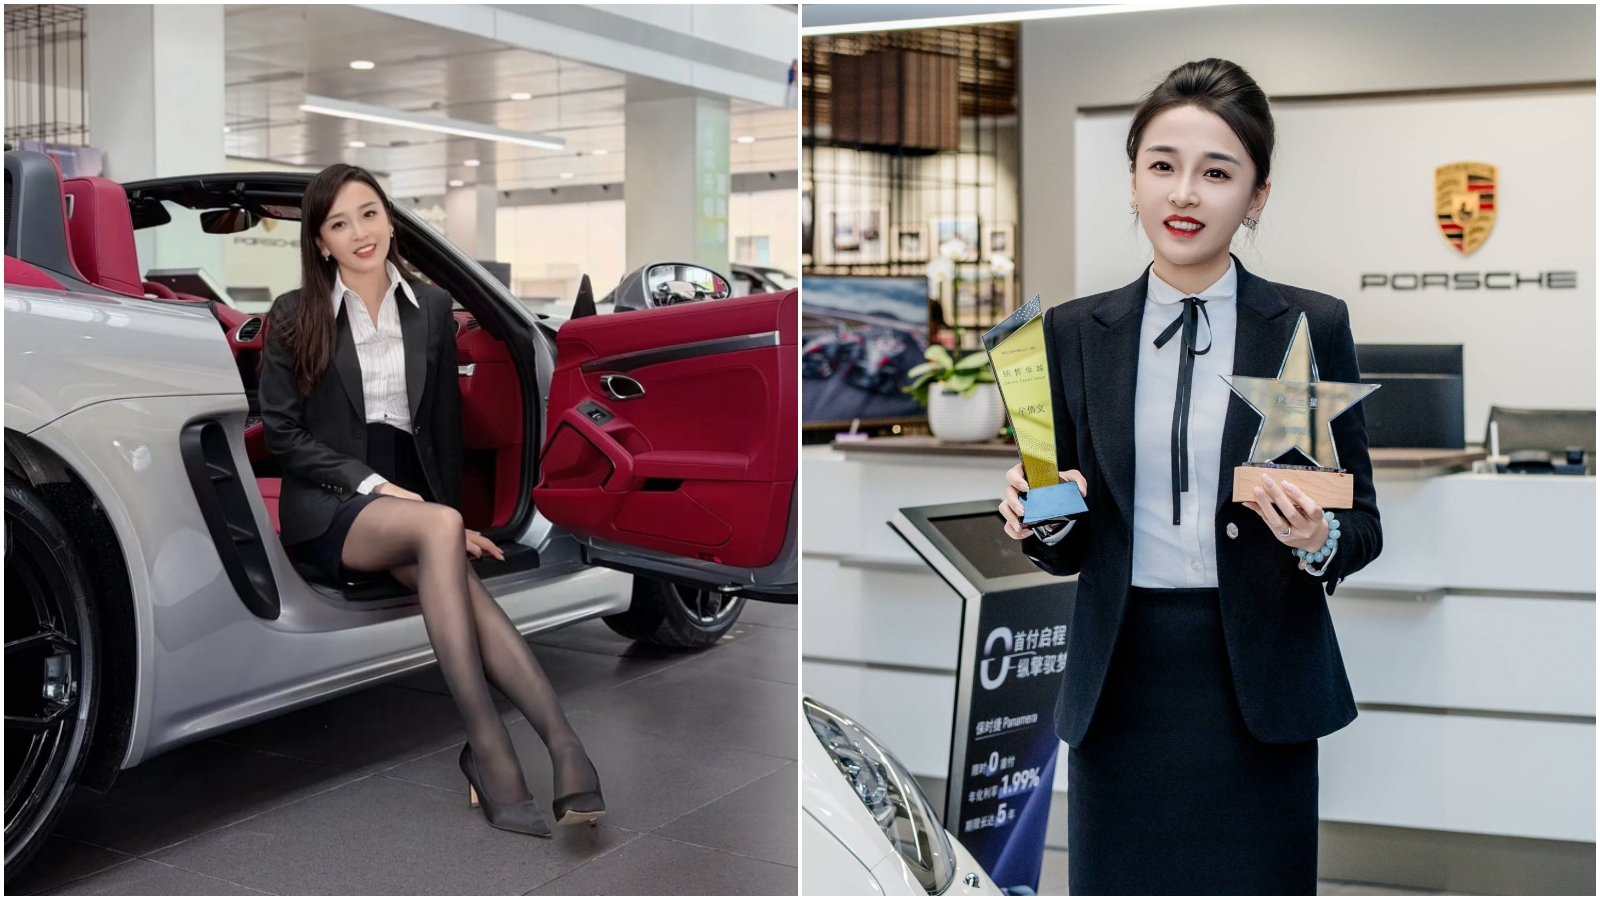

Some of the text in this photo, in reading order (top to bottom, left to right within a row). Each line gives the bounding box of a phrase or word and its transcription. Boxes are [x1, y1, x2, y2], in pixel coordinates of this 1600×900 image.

[1360, 271, 1578, 291] PORSCHE
[1002, 364, 1044, 378] 销售卓越
[1013, 624, 1067, 653] 首付启程
[976, 713, 1038, 736] 保时捷 Panamera
